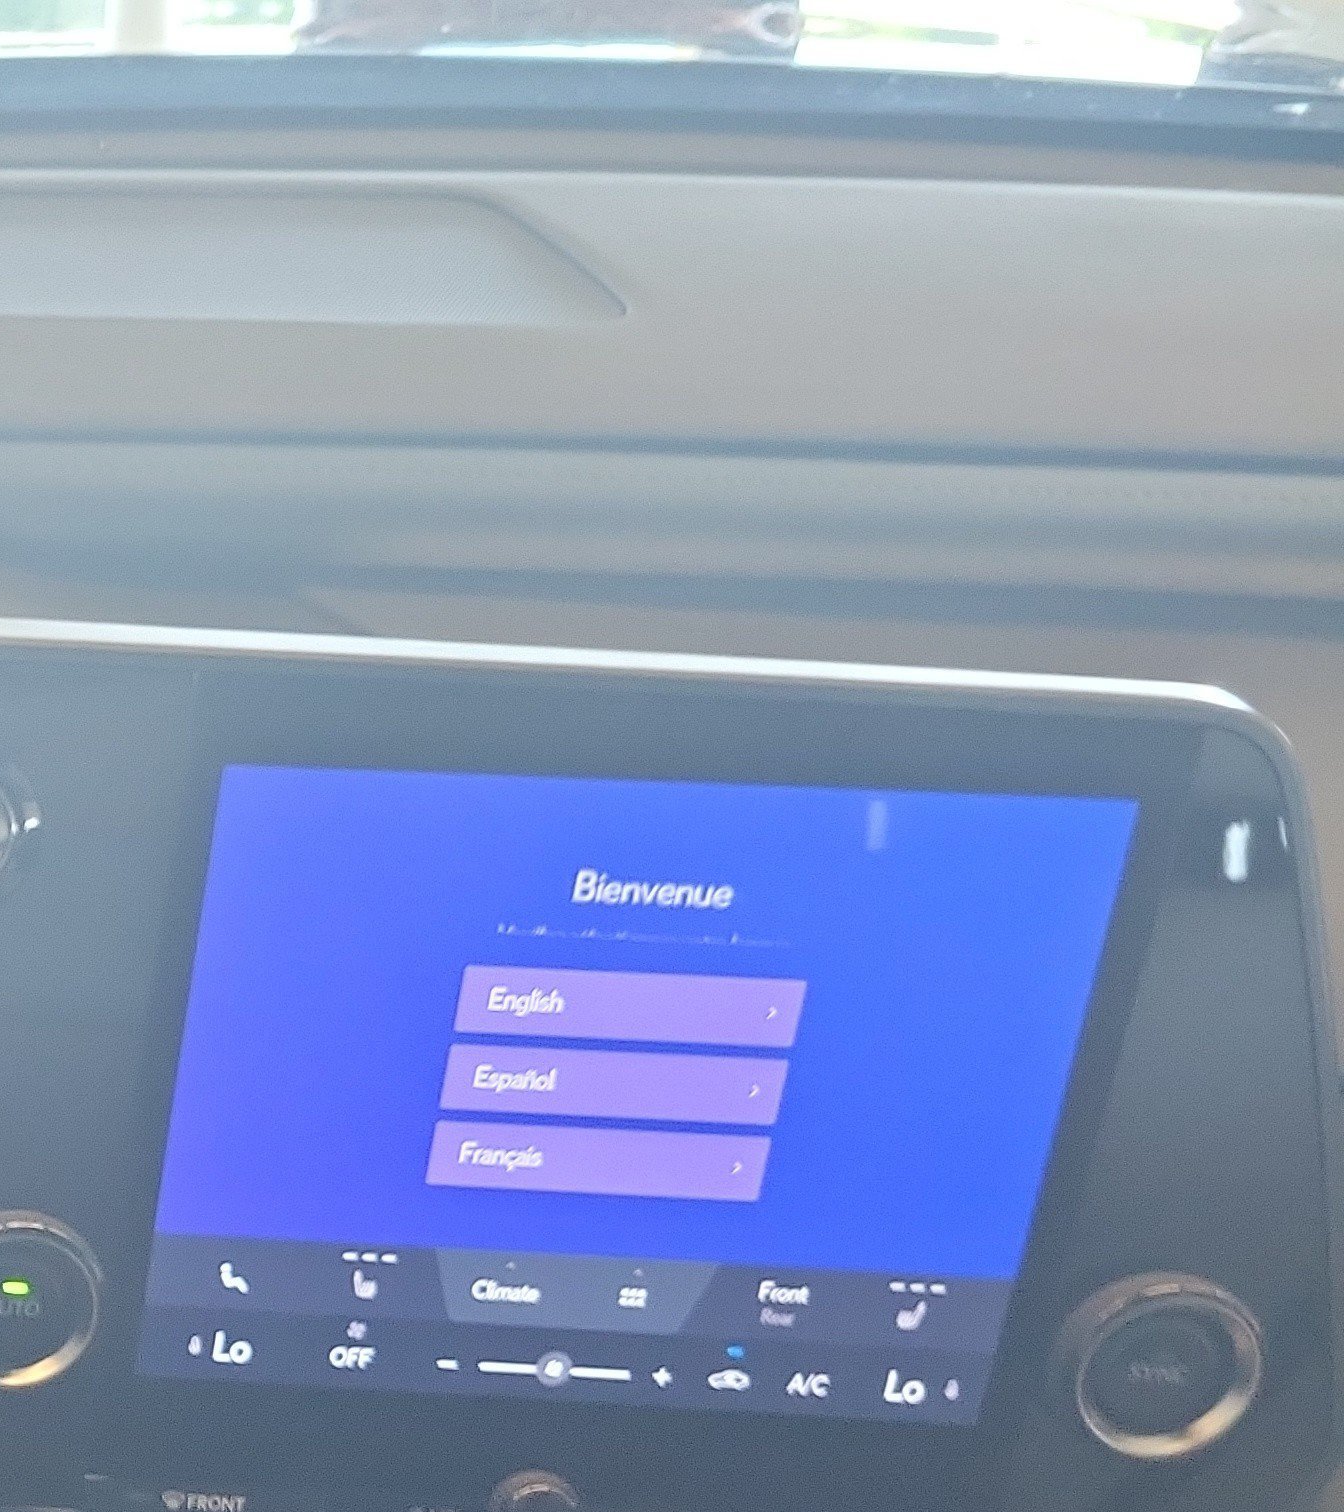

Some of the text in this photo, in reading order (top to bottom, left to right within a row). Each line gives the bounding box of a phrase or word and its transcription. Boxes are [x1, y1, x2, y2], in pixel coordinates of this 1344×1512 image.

[571, 867, 734, 910] Bienvenue
[486, 985, 565, 1017] English
[472, 1064, 558, 1094] Español
[458, 1139, 543, 1172] Français
[471, 1277, 541, 1304] Climate
[758, 1279, 810, 1305] Front
[212, 1330, 253, 1365] Lo
[329, 1346, 376, 1370] OFF
[883, 1369, 926, 1405] Lo
